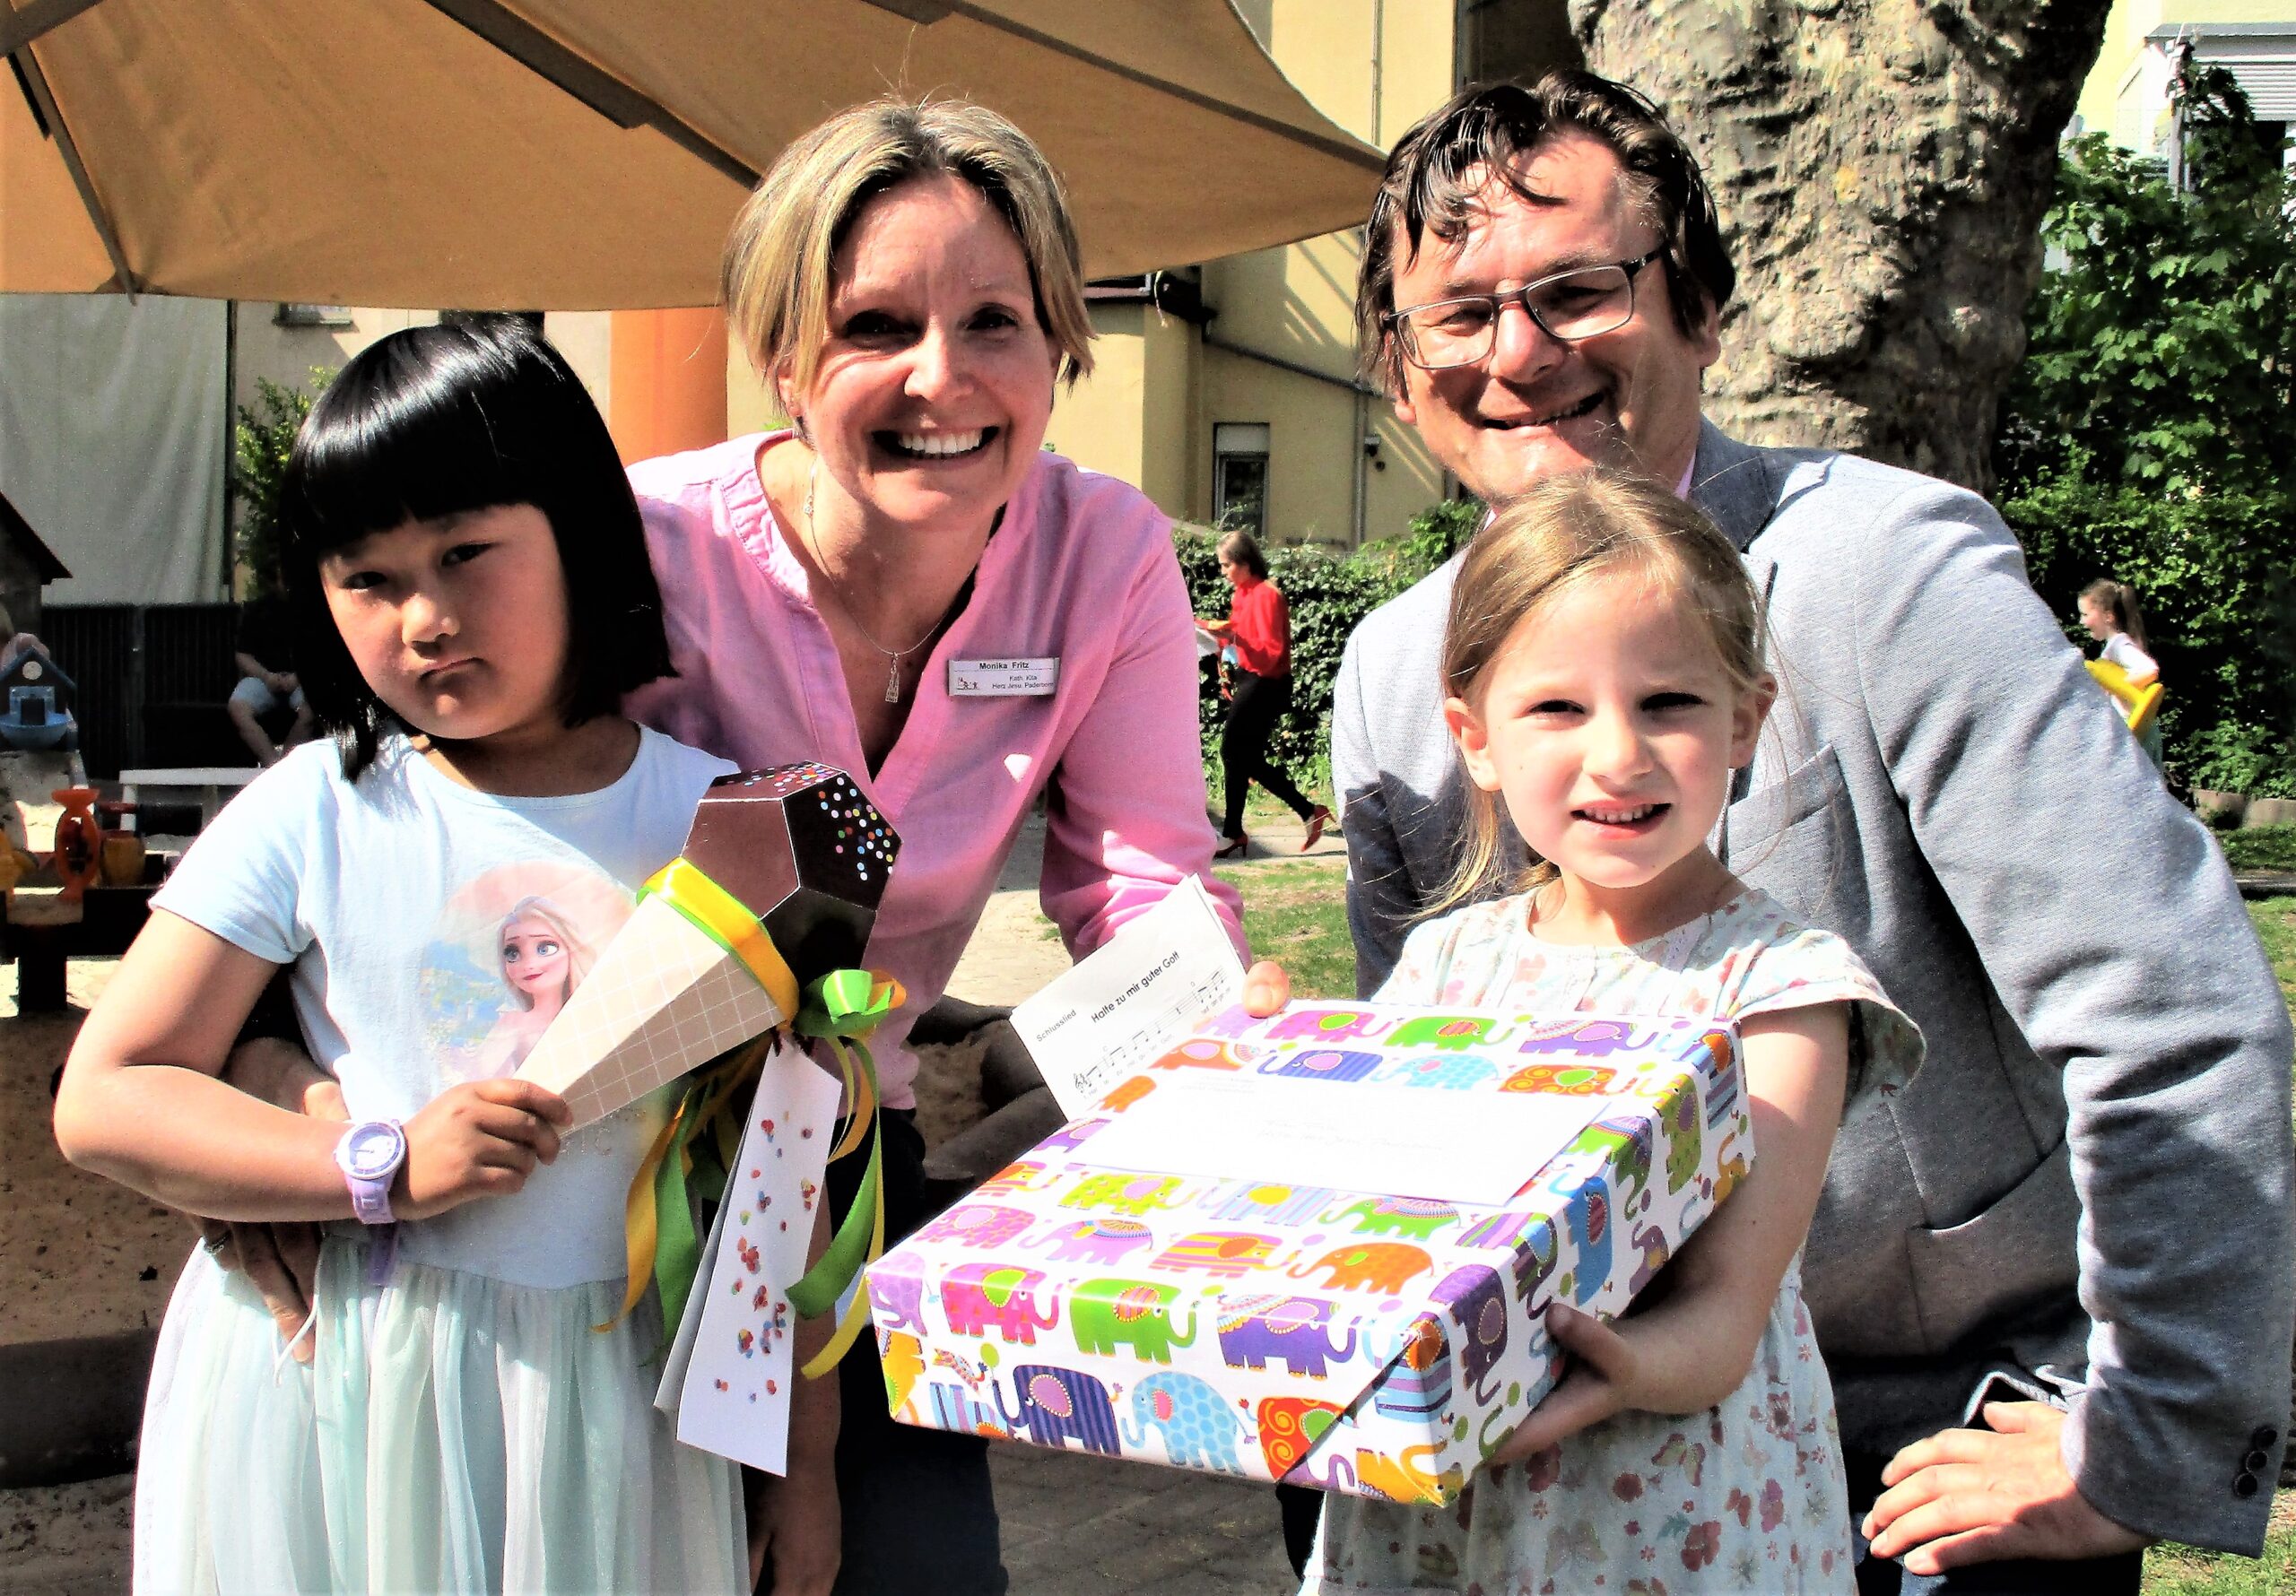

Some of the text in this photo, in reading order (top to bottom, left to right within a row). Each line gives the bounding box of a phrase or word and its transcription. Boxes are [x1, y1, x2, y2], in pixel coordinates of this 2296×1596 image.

[1091, 950, 1180, 1023] Halte zu mir guter Gott
[1037, 1010, 1076, 1042] Schlusslied
